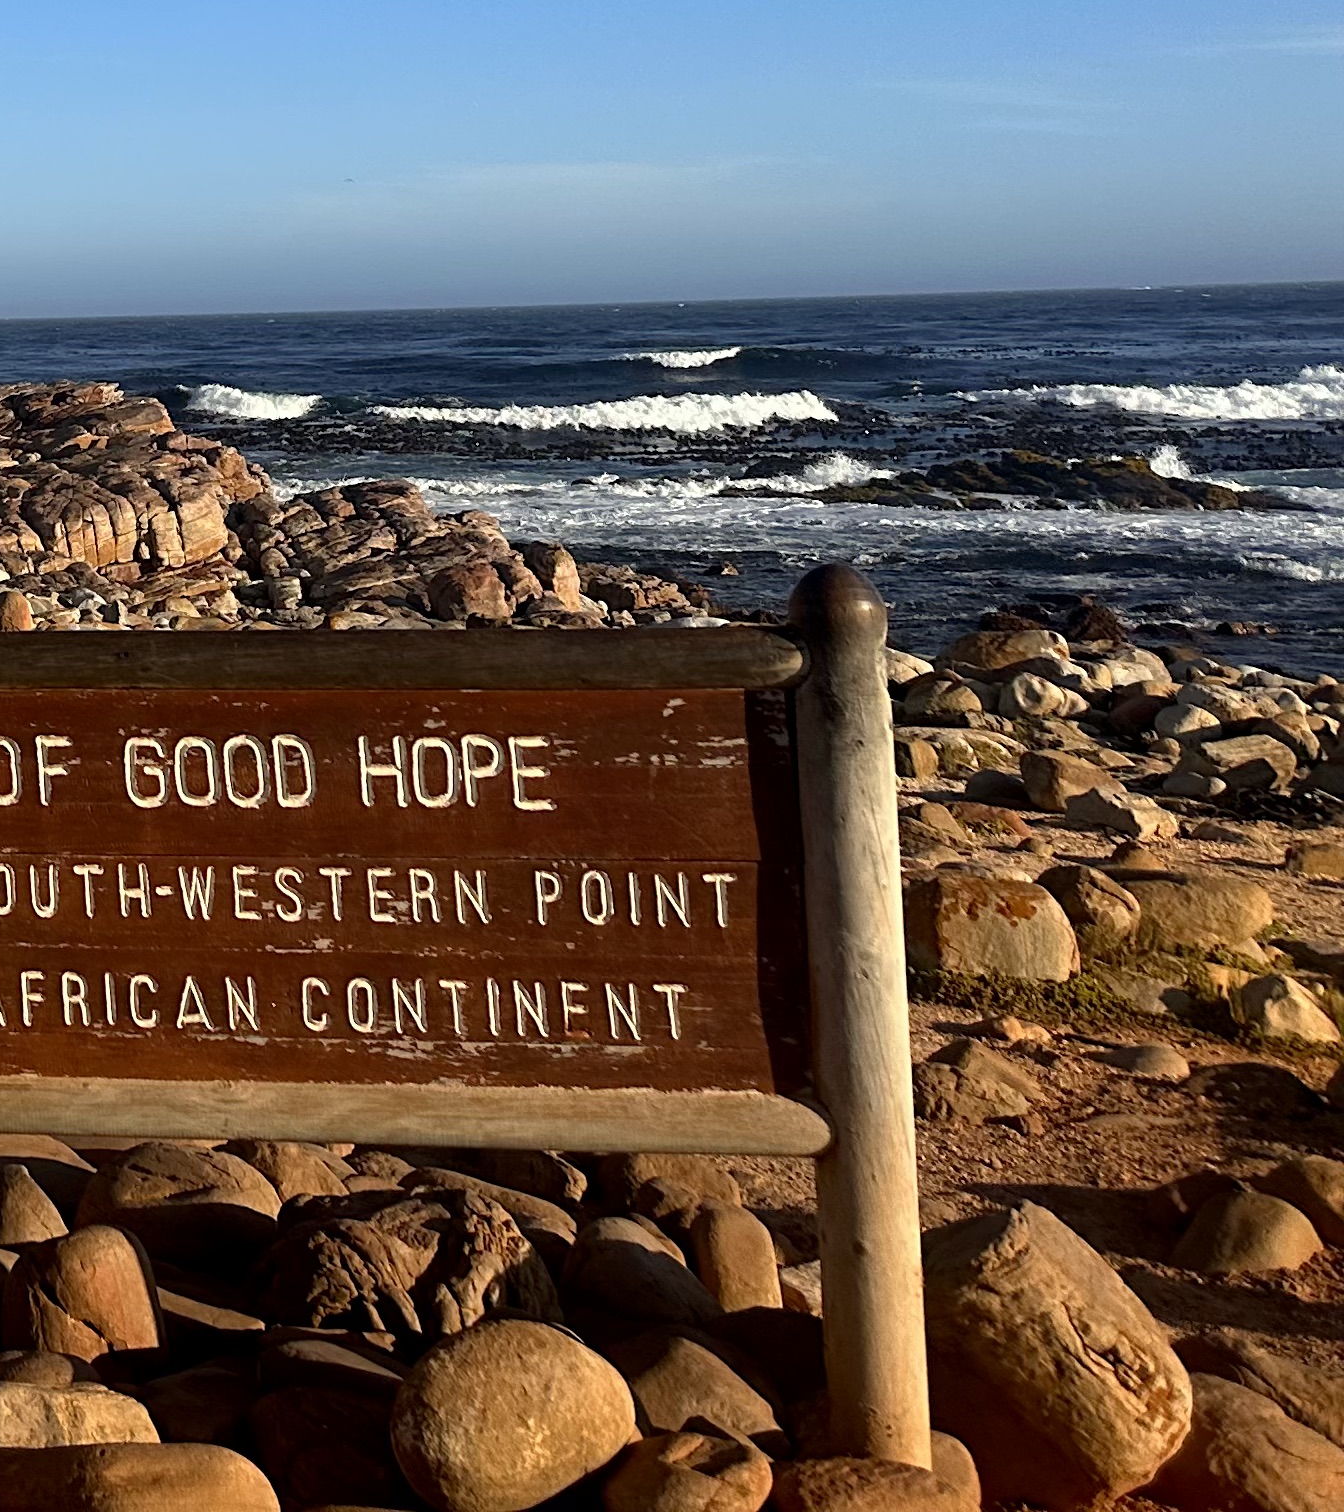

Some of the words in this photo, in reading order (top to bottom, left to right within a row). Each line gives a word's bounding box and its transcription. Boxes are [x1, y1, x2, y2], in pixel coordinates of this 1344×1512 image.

[124, 735, 316, 807] GOOD
[359, 735, 556, 810] HOPE
[534, 870, 738, 928] POINT
[300, 976, 690, 1039] CONTINENT
